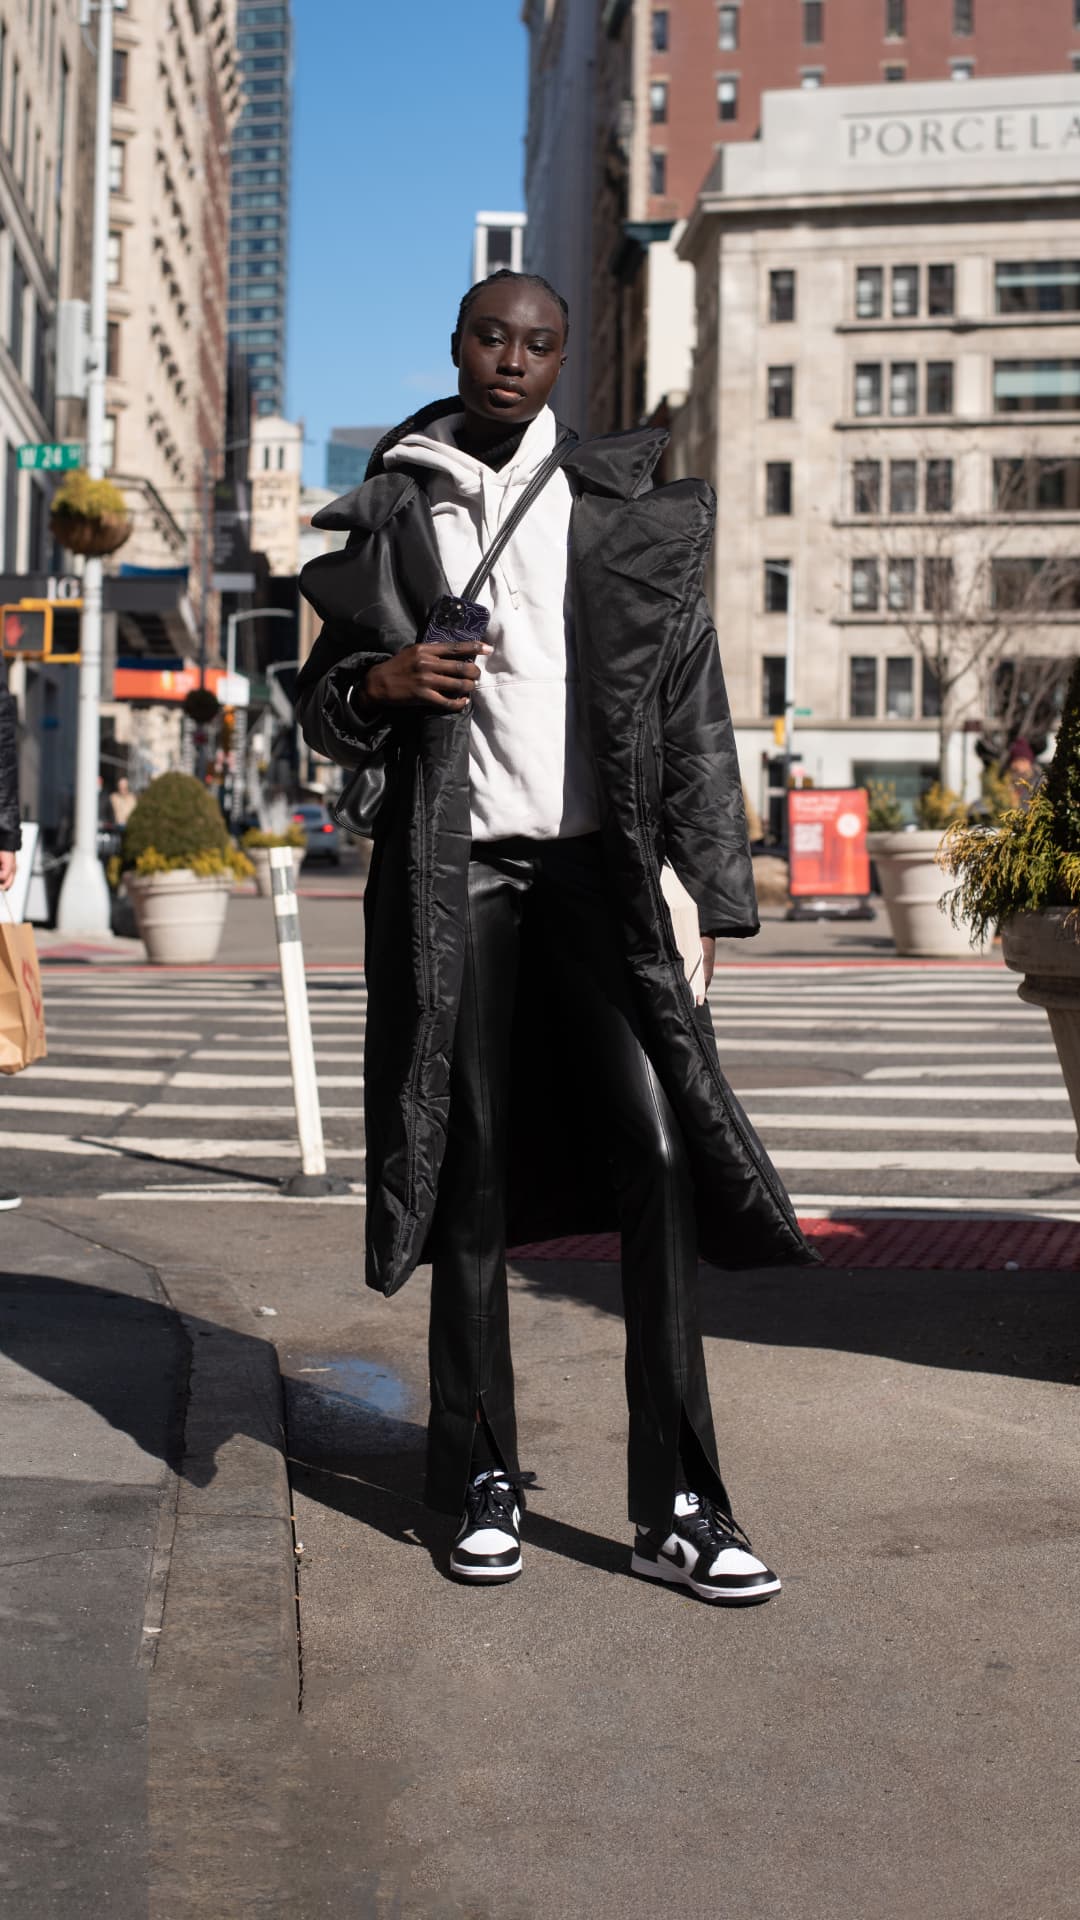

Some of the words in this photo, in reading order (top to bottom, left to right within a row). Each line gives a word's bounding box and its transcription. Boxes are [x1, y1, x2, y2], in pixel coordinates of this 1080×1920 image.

[848, 113, 1080, 157] PORCELA
[20, 447, 37, 467] W
[41, 446, 62, 468] 24
